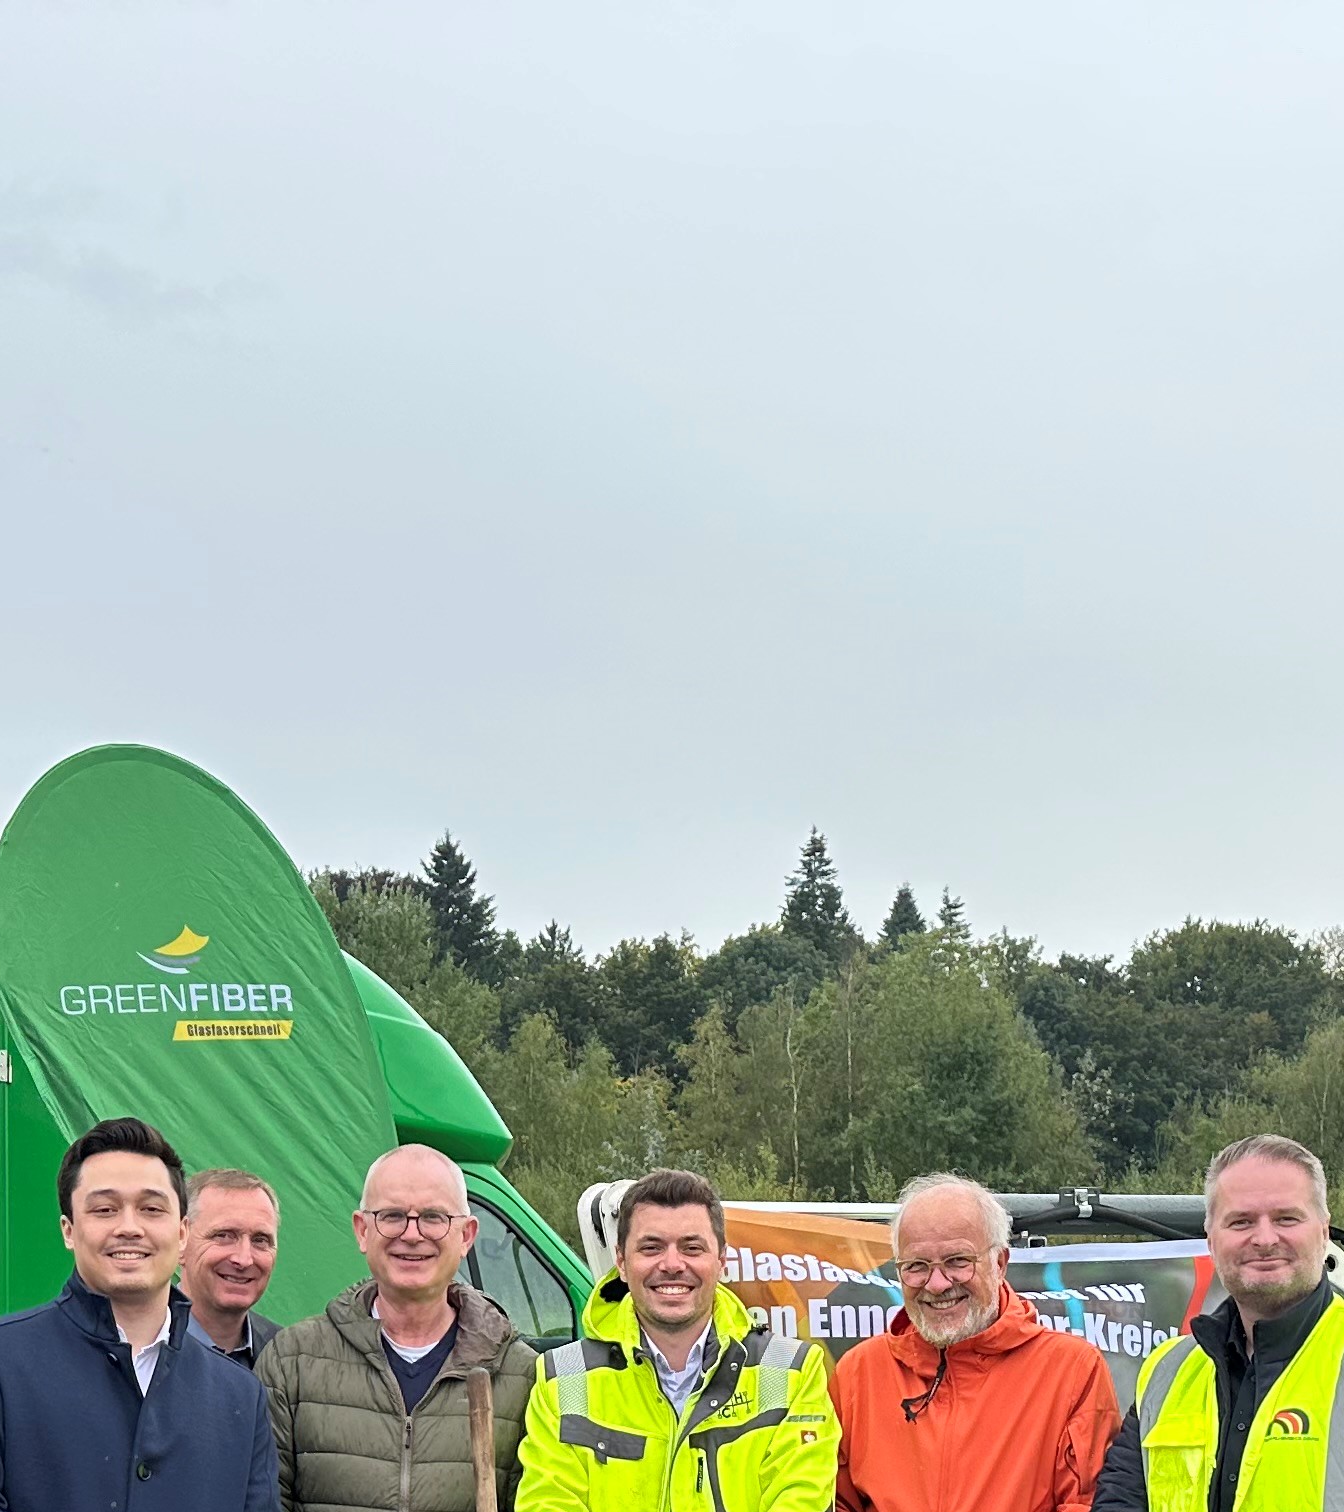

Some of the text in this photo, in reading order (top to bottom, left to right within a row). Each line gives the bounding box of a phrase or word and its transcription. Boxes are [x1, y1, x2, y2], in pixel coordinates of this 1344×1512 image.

[59, 983, 294, 1015] GREENFIBER
[186, 1024, 282, 1037] Glasfaserschnell
[1084, 1282, 1146, 1304] für
[745, 1305, 798, 1339] en
